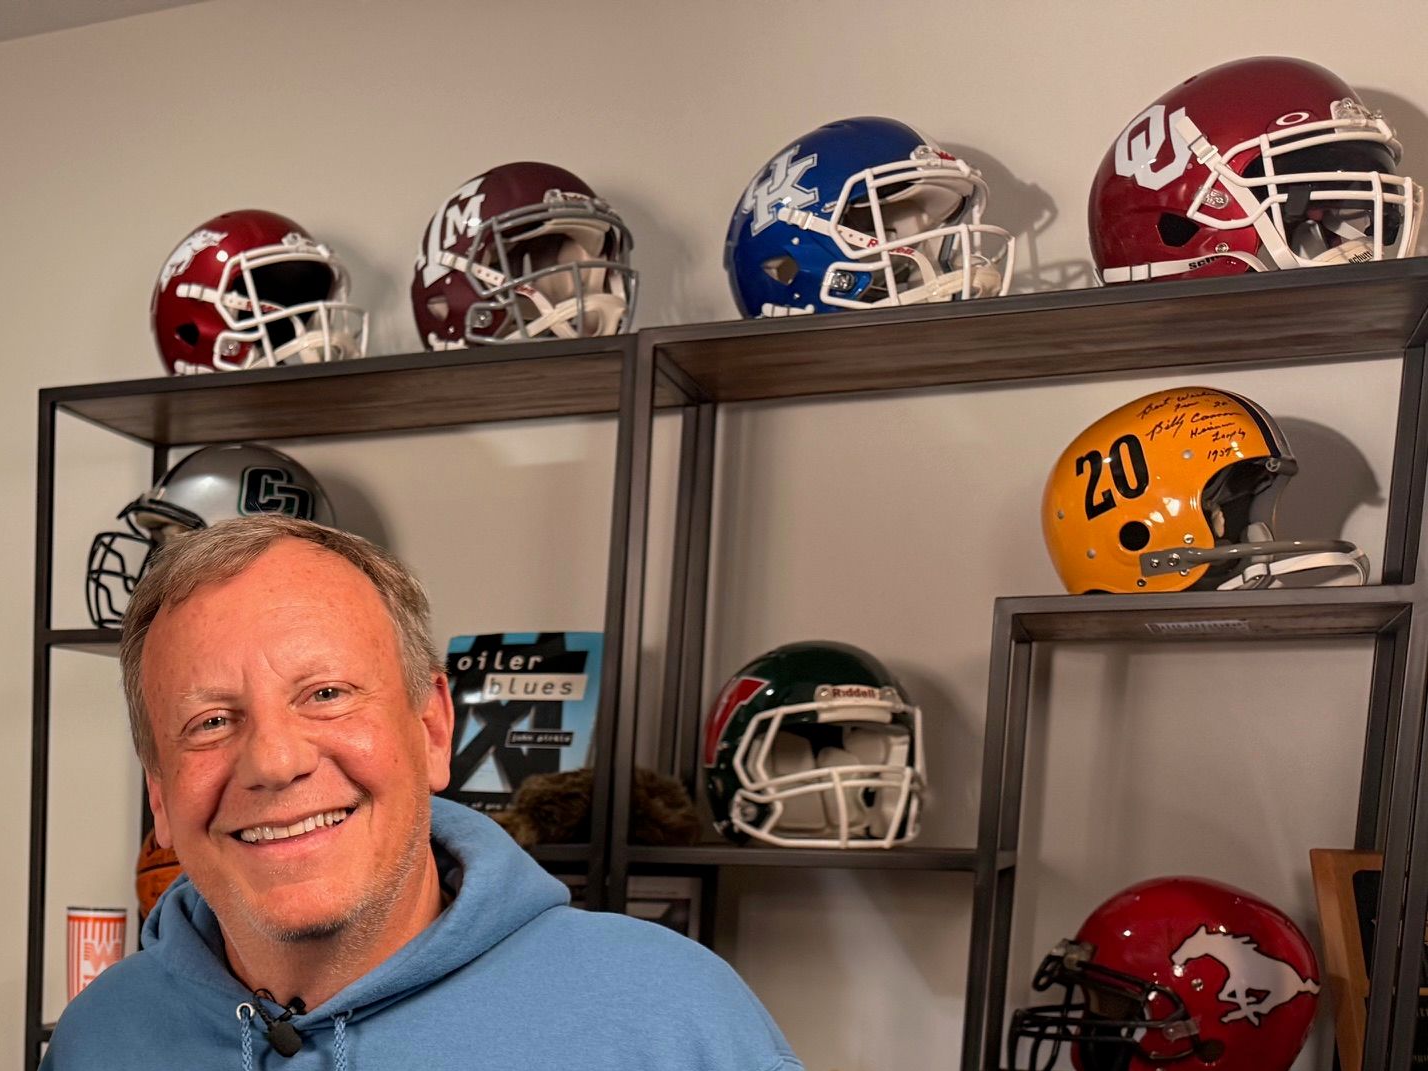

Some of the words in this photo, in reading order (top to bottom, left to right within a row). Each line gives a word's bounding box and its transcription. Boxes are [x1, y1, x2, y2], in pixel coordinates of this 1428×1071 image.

[1075, 434, 1149, 521] 20
[456, 649, 543, 671] oiler
[489, 677, 573, 696] blues
[832, 687, 876, 699] Riddell
